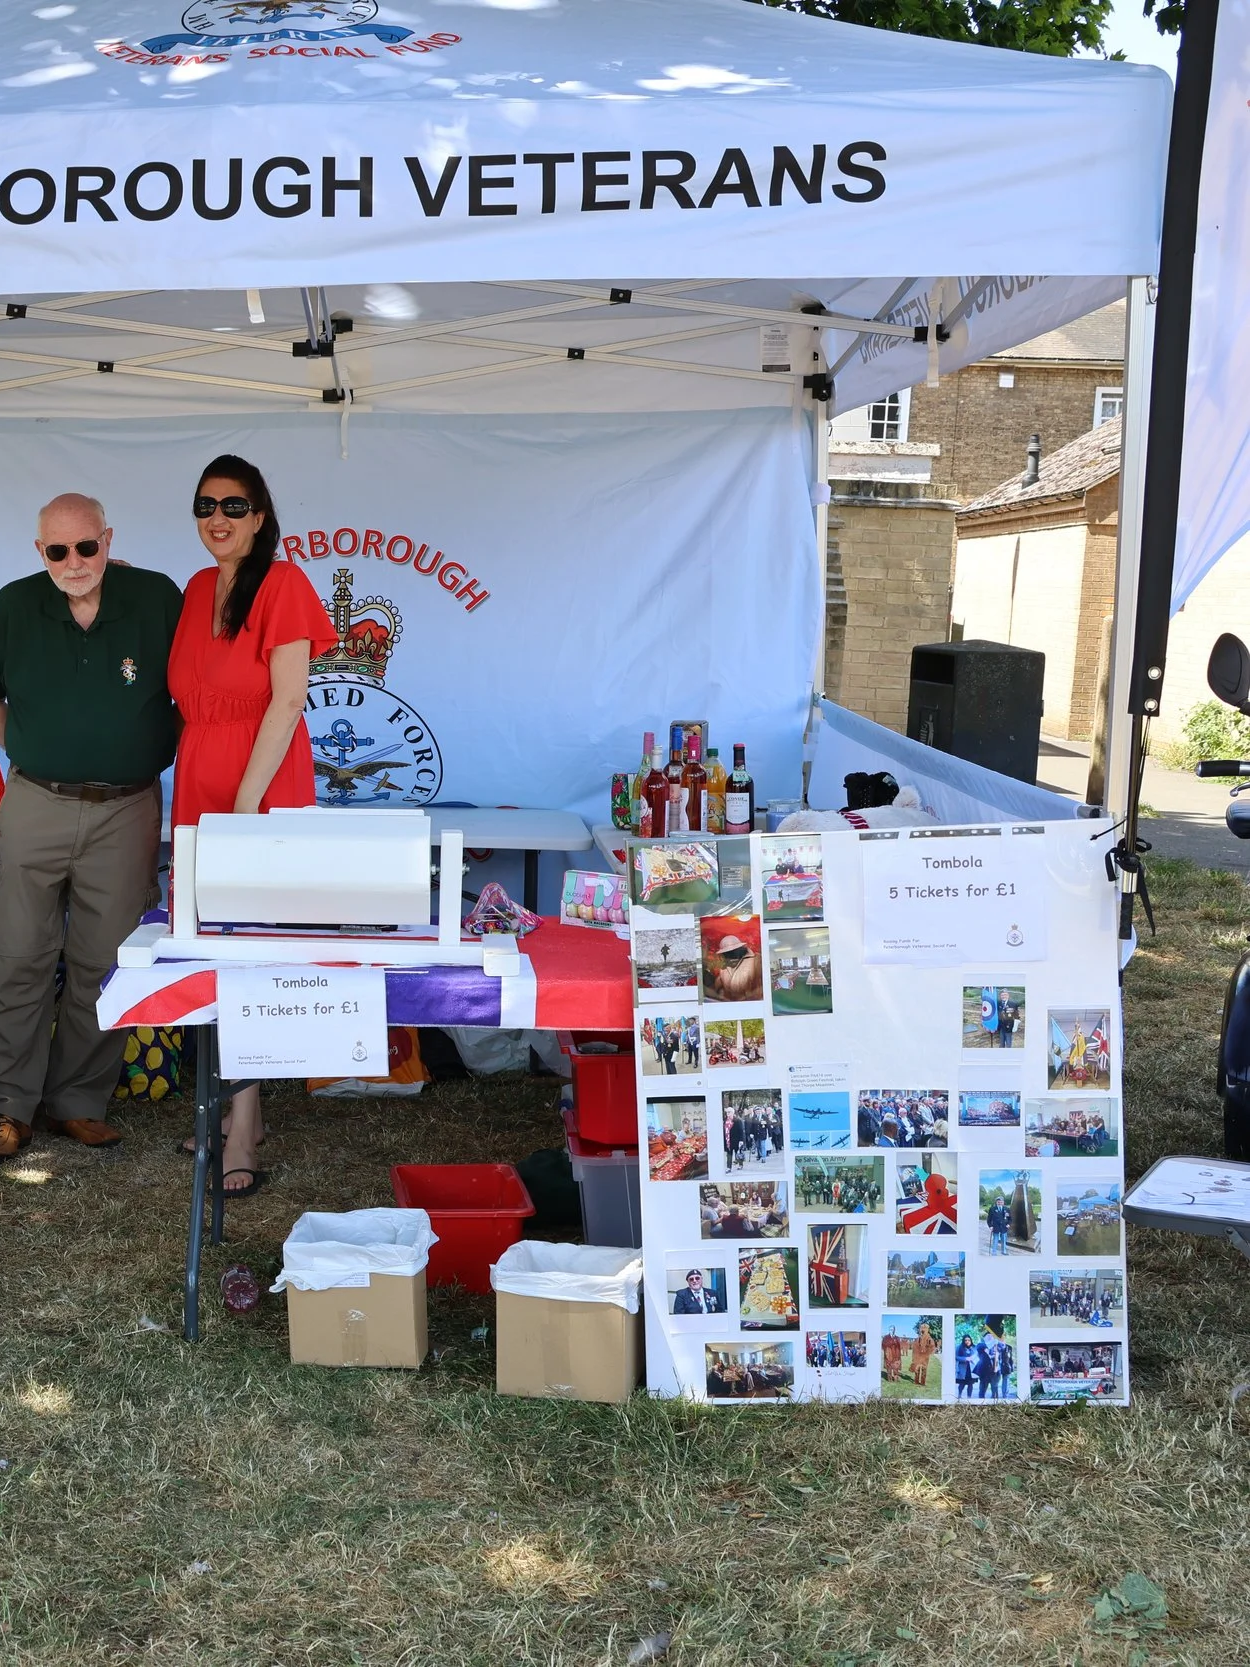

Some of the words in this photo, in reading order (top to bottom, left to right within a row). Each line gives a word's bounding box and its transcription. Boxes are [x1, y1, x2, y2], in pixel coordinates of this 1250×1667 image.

[99, 41, 231, 67] VETERANS
[247, 44, 377, 60] SOCIAL
[385, 31, 463, 57] FUND
[404, 140, 888, 218] VETERANS
[922, 855, 983, 869] Tombola
[889, 887, 898, 899] 5
[905, 885, 959, 899] Tickets
[965, 884, 989, 898] for
[996, 882, 1016, 896] £1
[272, 975, 329, 989] Tombola
[242, 1005, 250, 1017] 5
[257, 1004, 307, 1017] Tickets
[313, 1002, 335, 1015] for
[341, 1001, 360, 1014] £1
